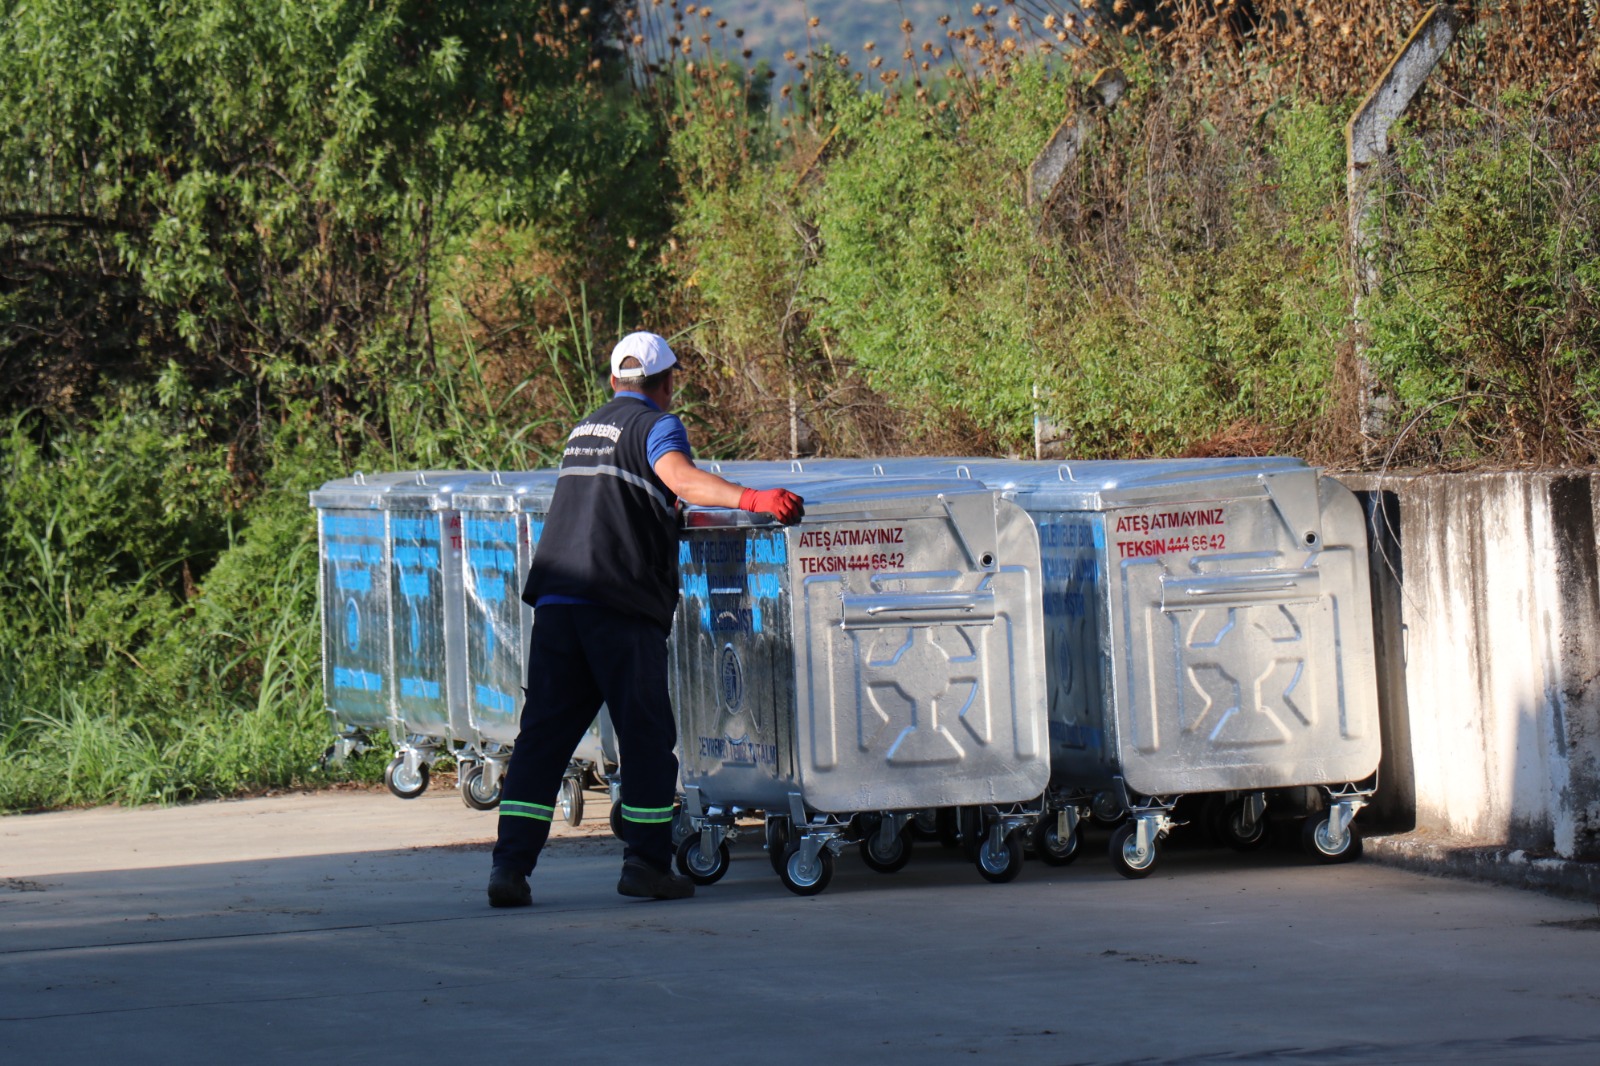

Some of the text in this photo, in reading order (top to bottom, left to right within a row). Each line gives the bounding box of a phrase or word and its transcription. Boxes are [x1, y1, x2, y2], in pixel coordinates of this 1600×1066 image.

[1116, 509, 1224, 536] ATEŞ ATMAYINIZ
[799, 527, 904, 551] ATEŞ ATMAYINIZ
[1167, 536, 1190, 553] 444
[1209, 534, 1226, 550] 42
[848, 554, 870, 571] 444
[888, 552, 905, 568] 42
